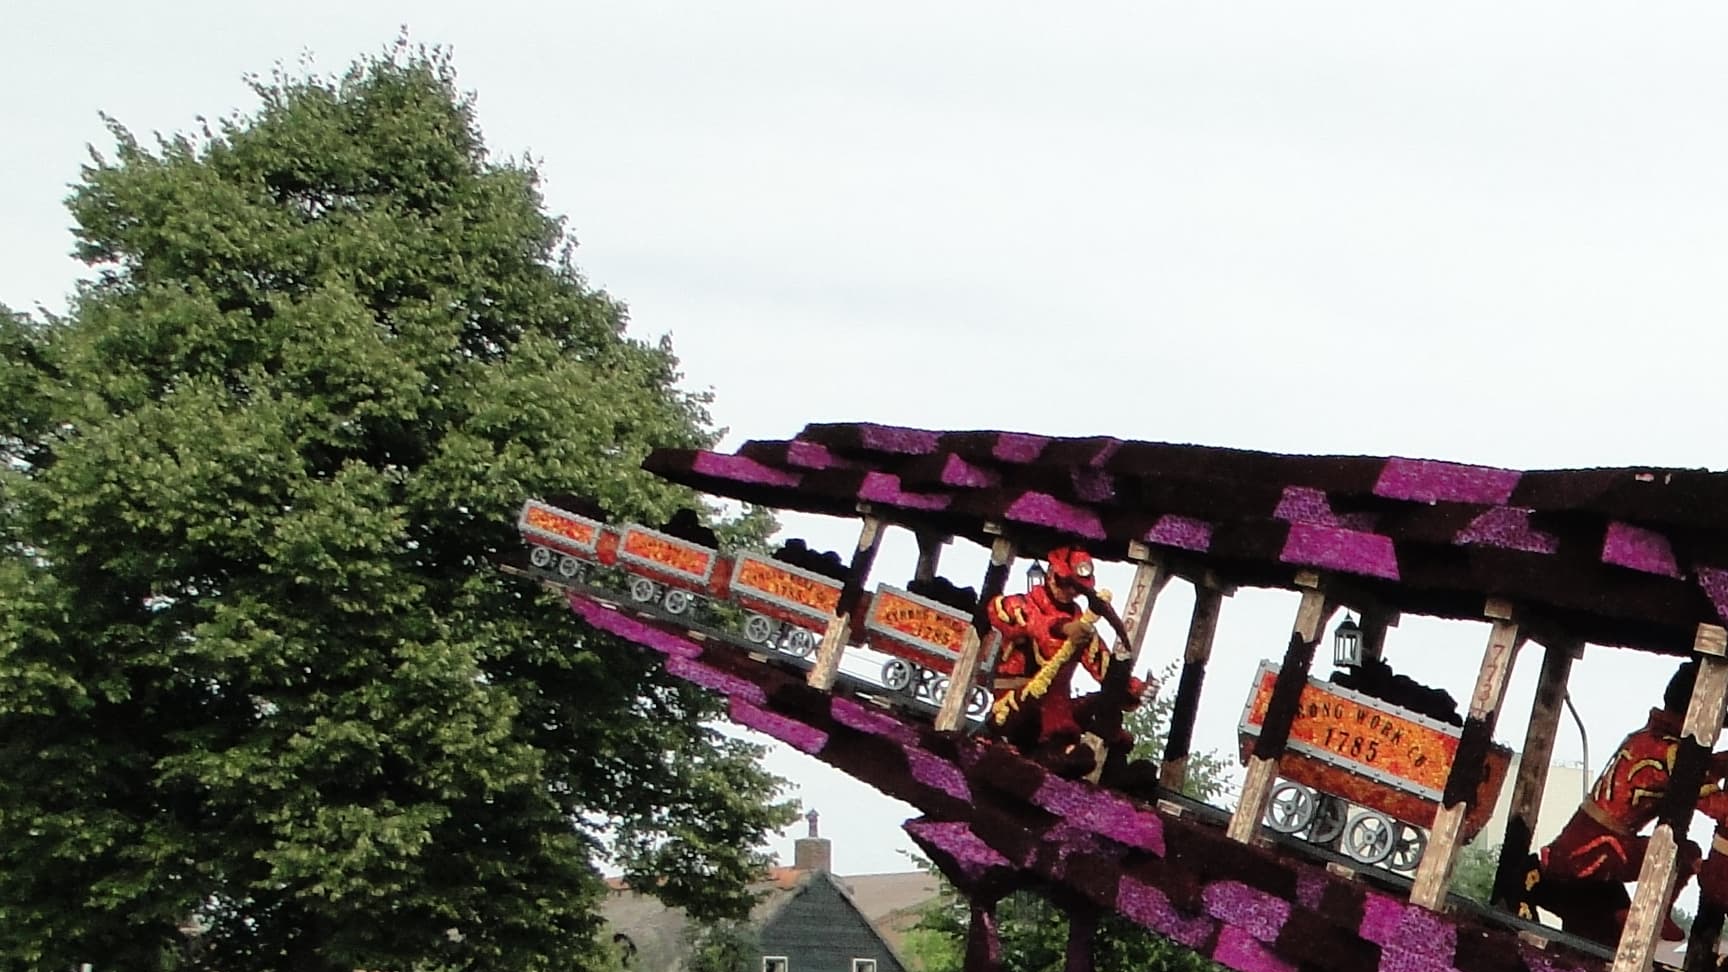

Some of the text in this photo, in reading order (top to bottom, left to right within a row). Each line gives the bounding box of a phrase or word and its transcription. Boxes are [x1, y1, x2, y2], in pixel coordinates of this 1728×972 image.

[1296, 703, 1344, 719] RONG
[1356, 709, 1402, 745] WORK
[1324, 727, 1379, 762] 1785
